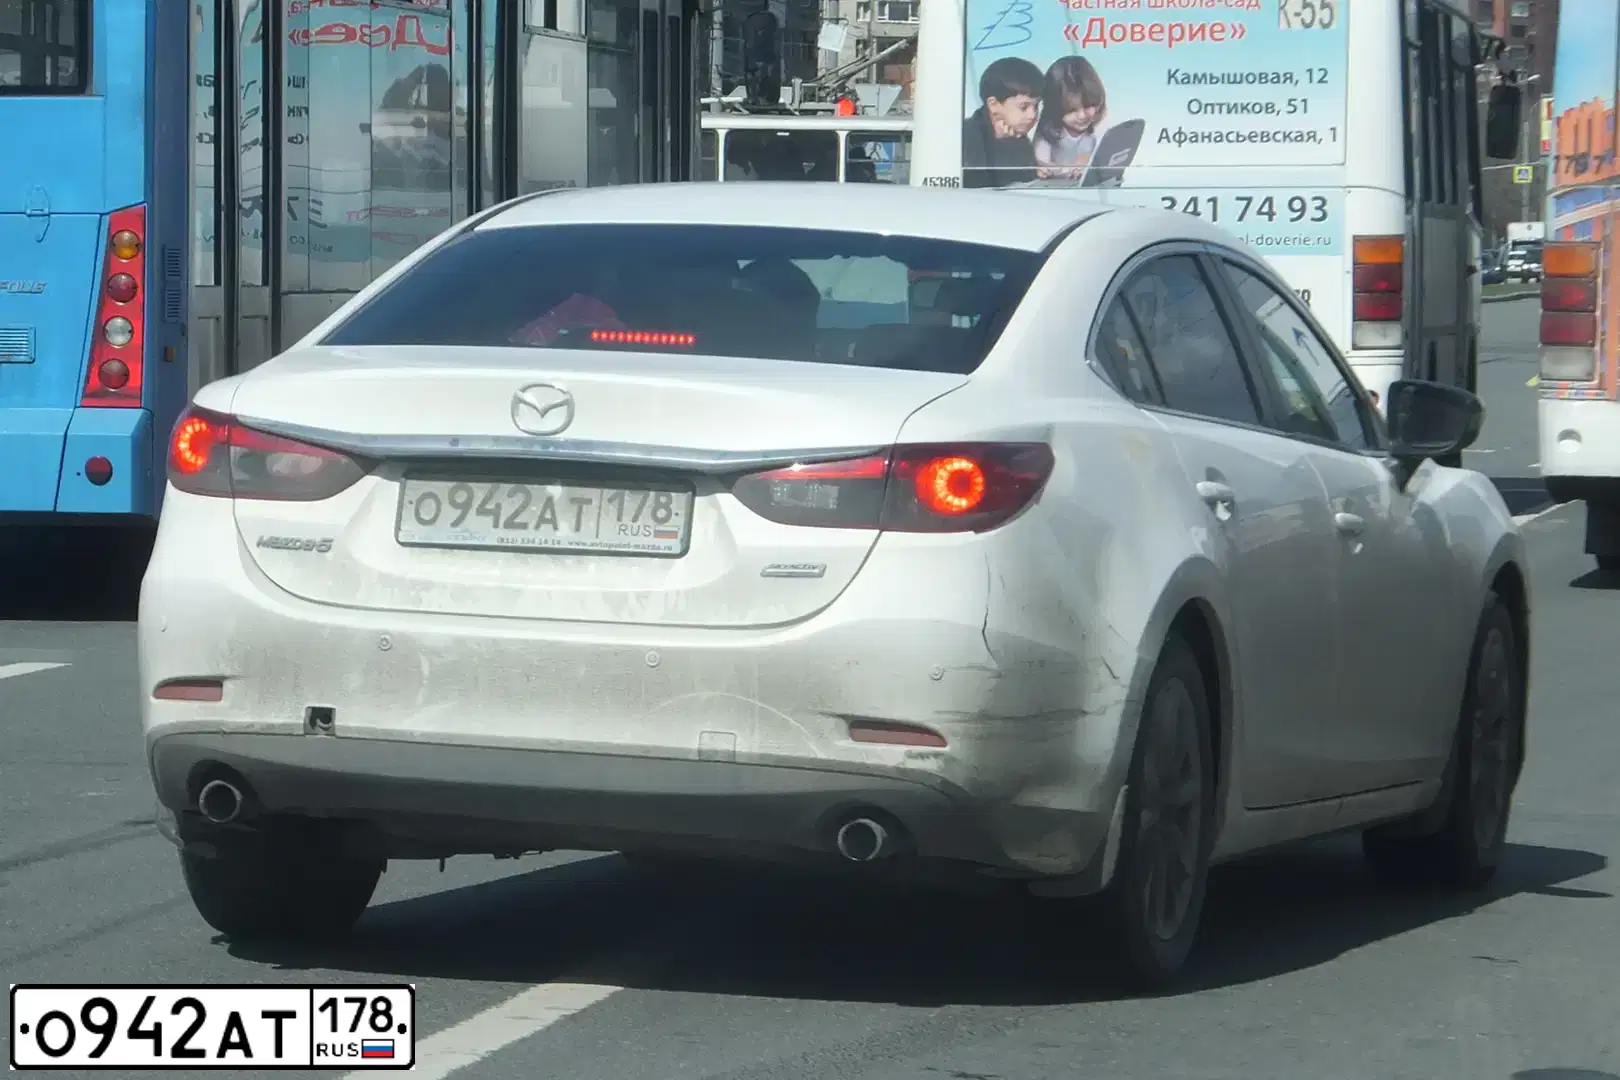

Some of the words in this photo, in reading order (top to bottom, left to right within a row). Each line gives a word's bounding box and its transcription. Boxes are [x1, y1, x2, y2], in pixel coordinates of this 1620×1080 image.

[1063, 17, 1246, 48] «Доверие»
[1167, 68, 1300, 87] Камышовая,
[1306, 67, 1329, 84] 12
[1187, 98, 1281, 116] Оптиков,
[1286, 98, 1309, 114] 51
[1157, 126, 1323, 148] Афанасьевская,
[1330, 127, 1338, 142] 1
[1234, 196, 1277, 222] 74
[1287, 196, 1329, 222] 93
[607, 490, 674, 524] 178
[618, 524, 652, 538] RUS
